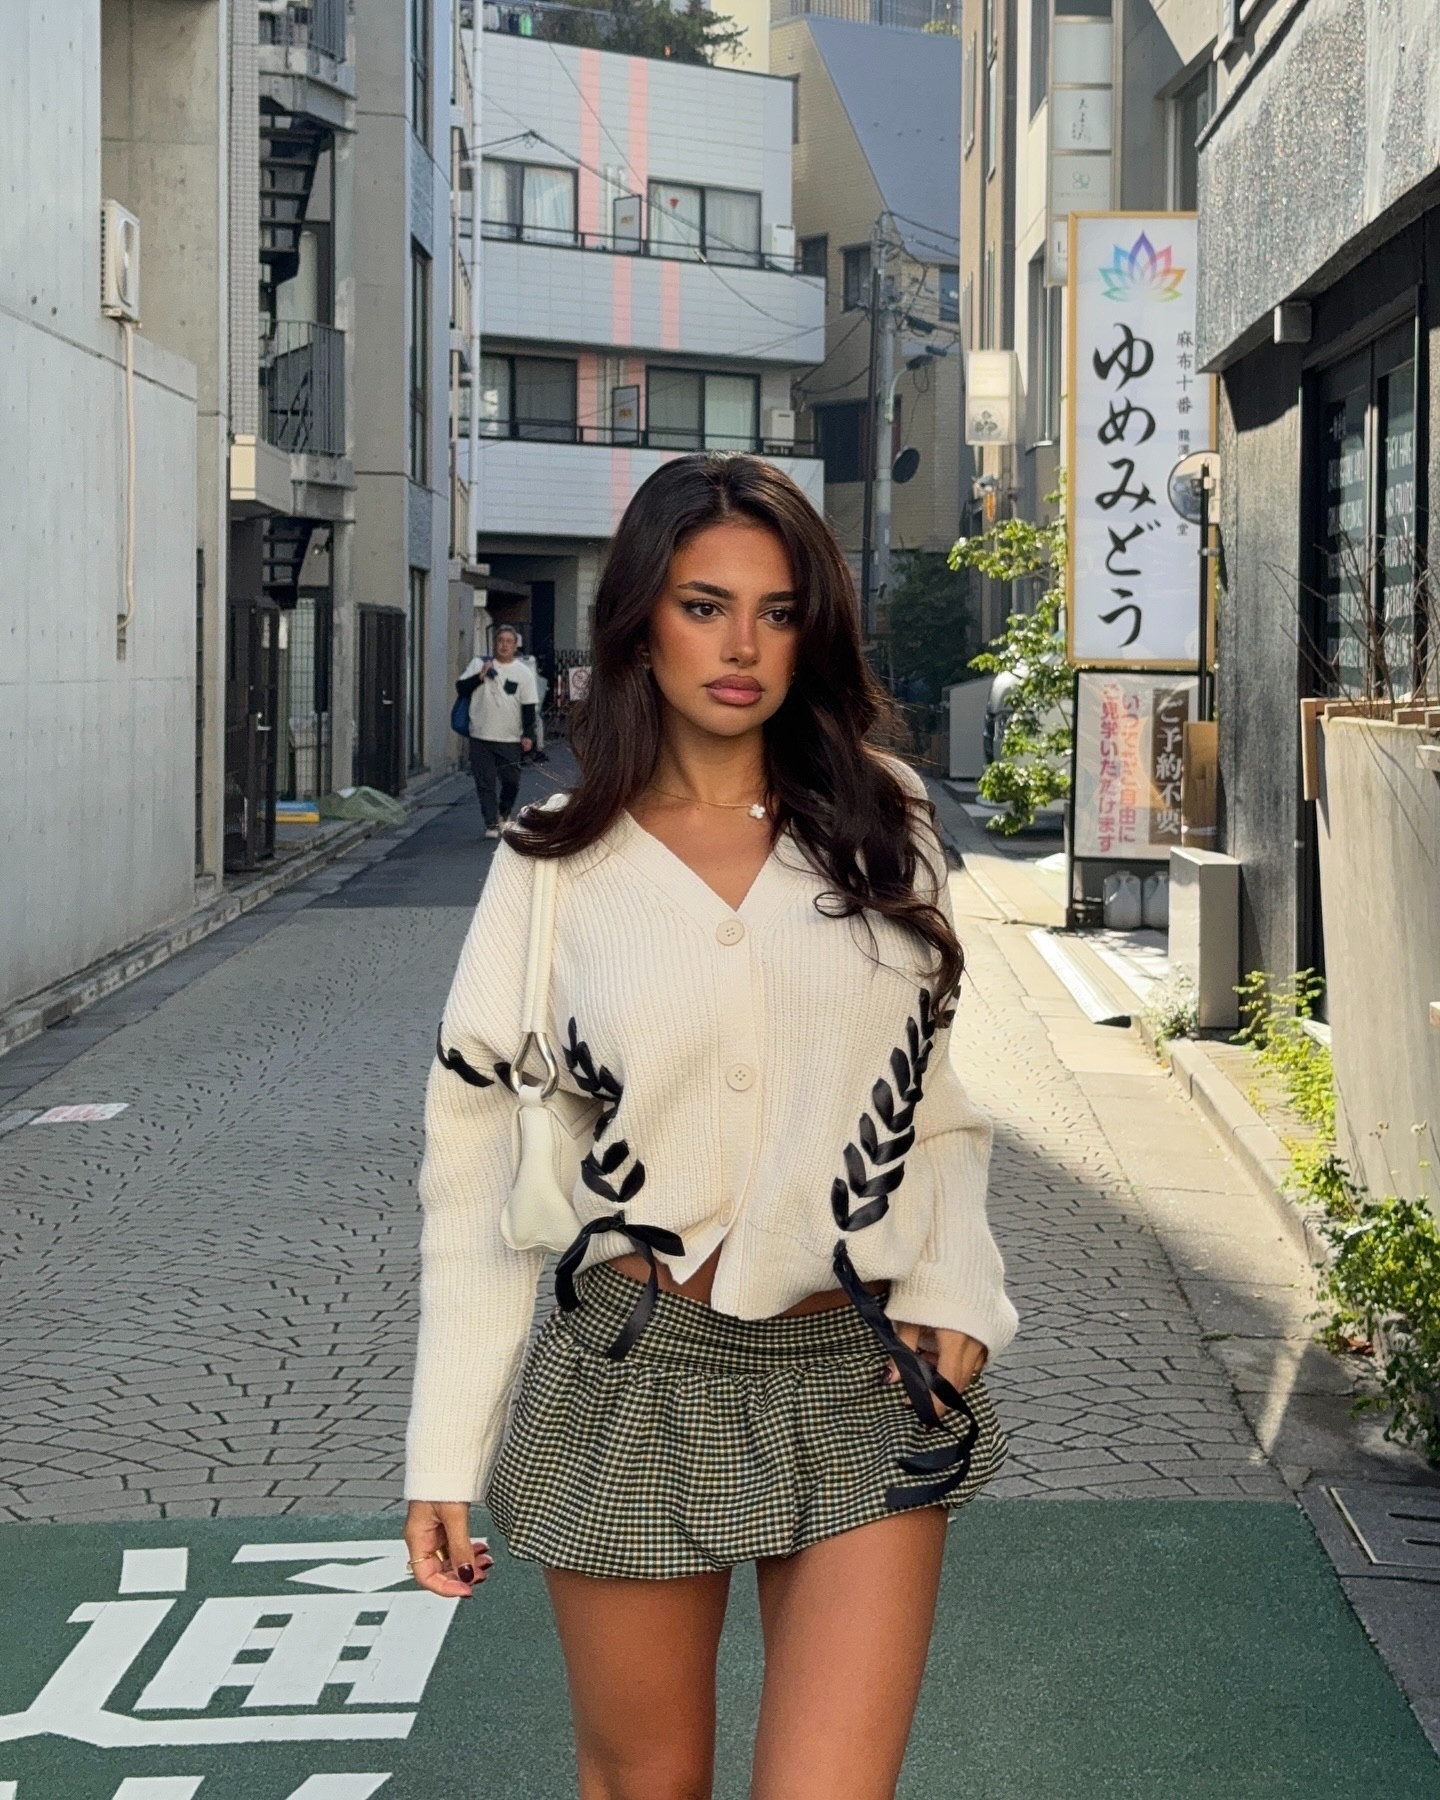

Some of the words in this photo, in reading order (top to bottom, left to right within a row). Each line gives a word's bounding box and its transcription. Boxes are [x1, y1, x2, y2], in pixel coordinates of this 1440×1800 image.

[1176, 330, 1194, 415] 麻布十番
[1093, 322, 1162, 649] ゆめみどう
[1155, 698, 1184, 836] ご予約不要
